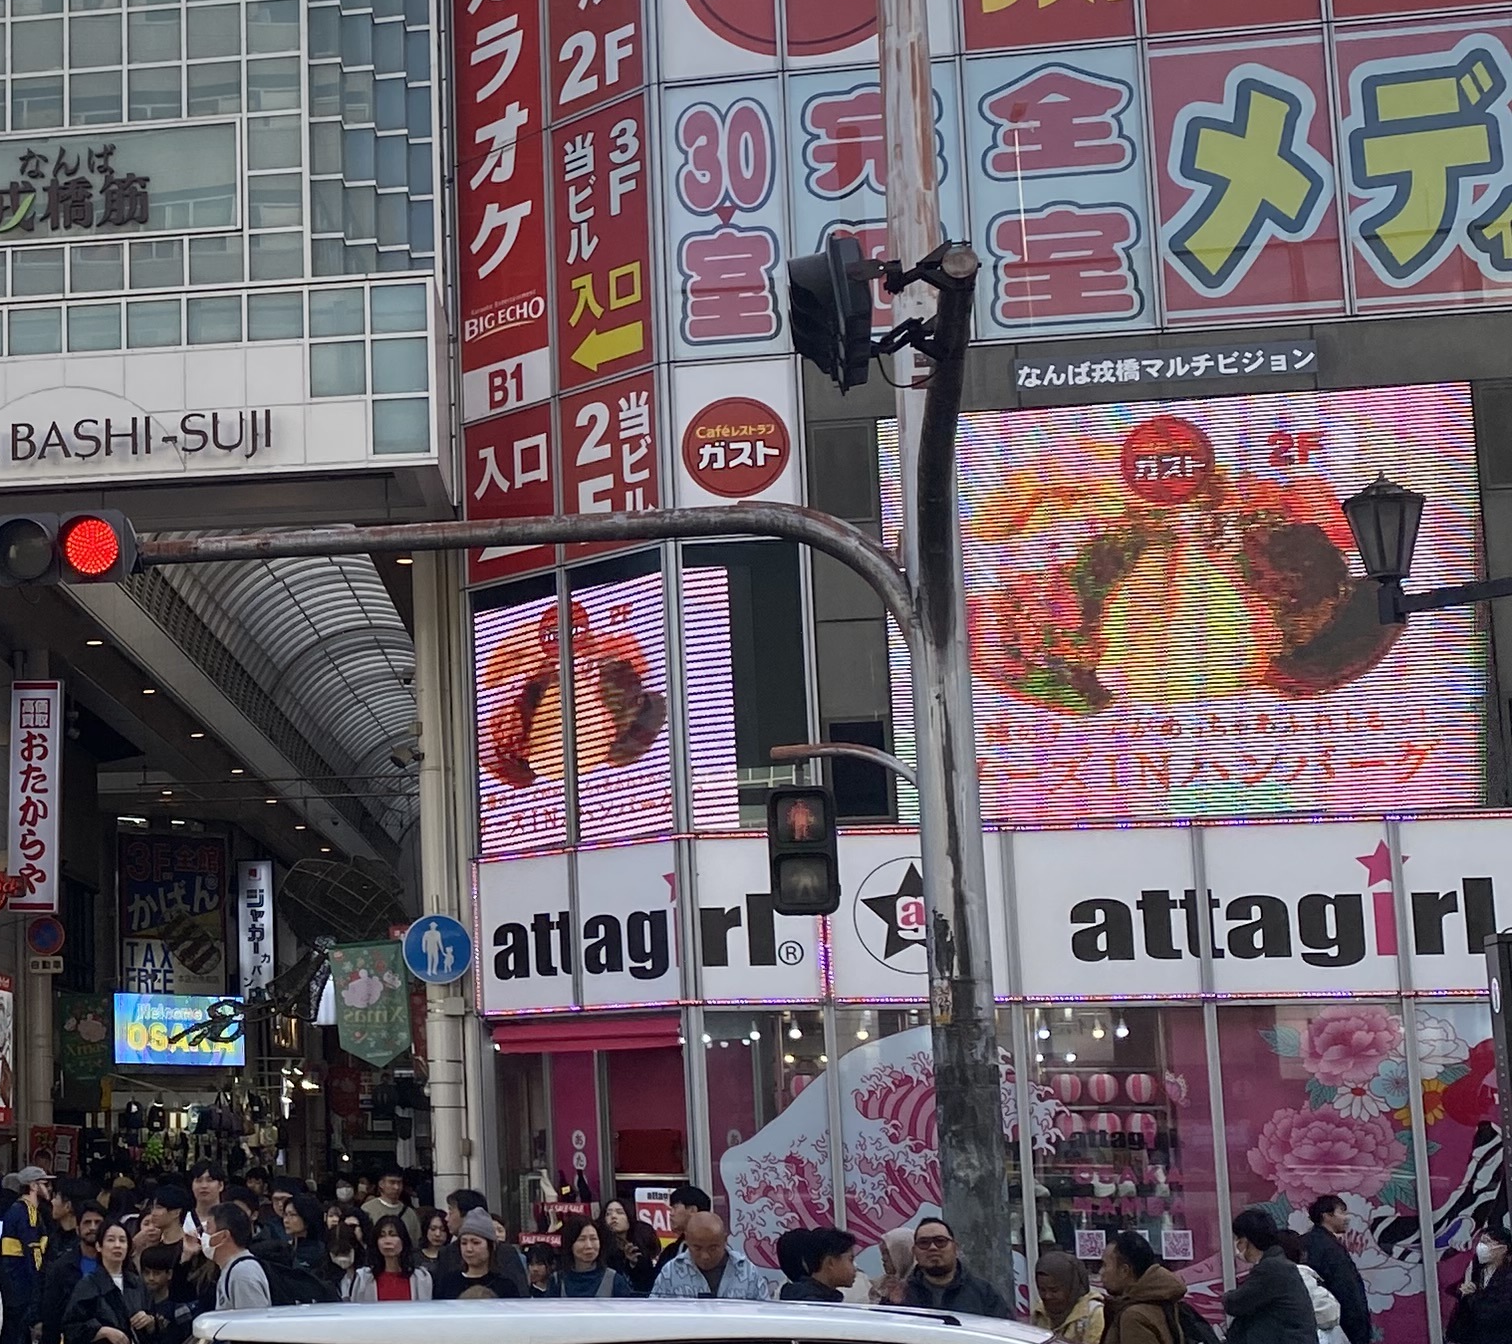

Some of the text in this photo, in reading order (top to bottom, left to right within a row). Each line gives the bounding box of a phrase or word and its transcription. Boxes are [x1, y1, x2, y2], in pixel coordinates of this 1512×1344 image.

[559, 22, 637, 106] 2F
[19, 143, 117, 178] なんば
[608, 119, 639, 216] 3F
[565, 132, 597, 267] 当ビル
[464, 296, 545, 343] BIG ECHO
[569, 261, 643, 328] 入口
[488, 362, 524, 414] B1
[1018, 348, 1315, 389] なんば戎橋マルチビジョン
[696, 424, 730, 439] Café
[698, 440, 781, 470] ガスト
[1267, 430, 1324, 467] 2F
[474, 433, 549, 501] 入口
[979, 739, 1443, 794] ーズINハンバーグ
[18, 730, 49, 895] おたからや
[128, 874, 219, 932] かばん
[246, 888, 266, 955] ジャガー
[1070, 858, 1492, 968] attagirl
[126, 941, 174, 969] TAX
[126, 967, 175, 993] FREE
[136, 1002, 203, 1021] Welcome
